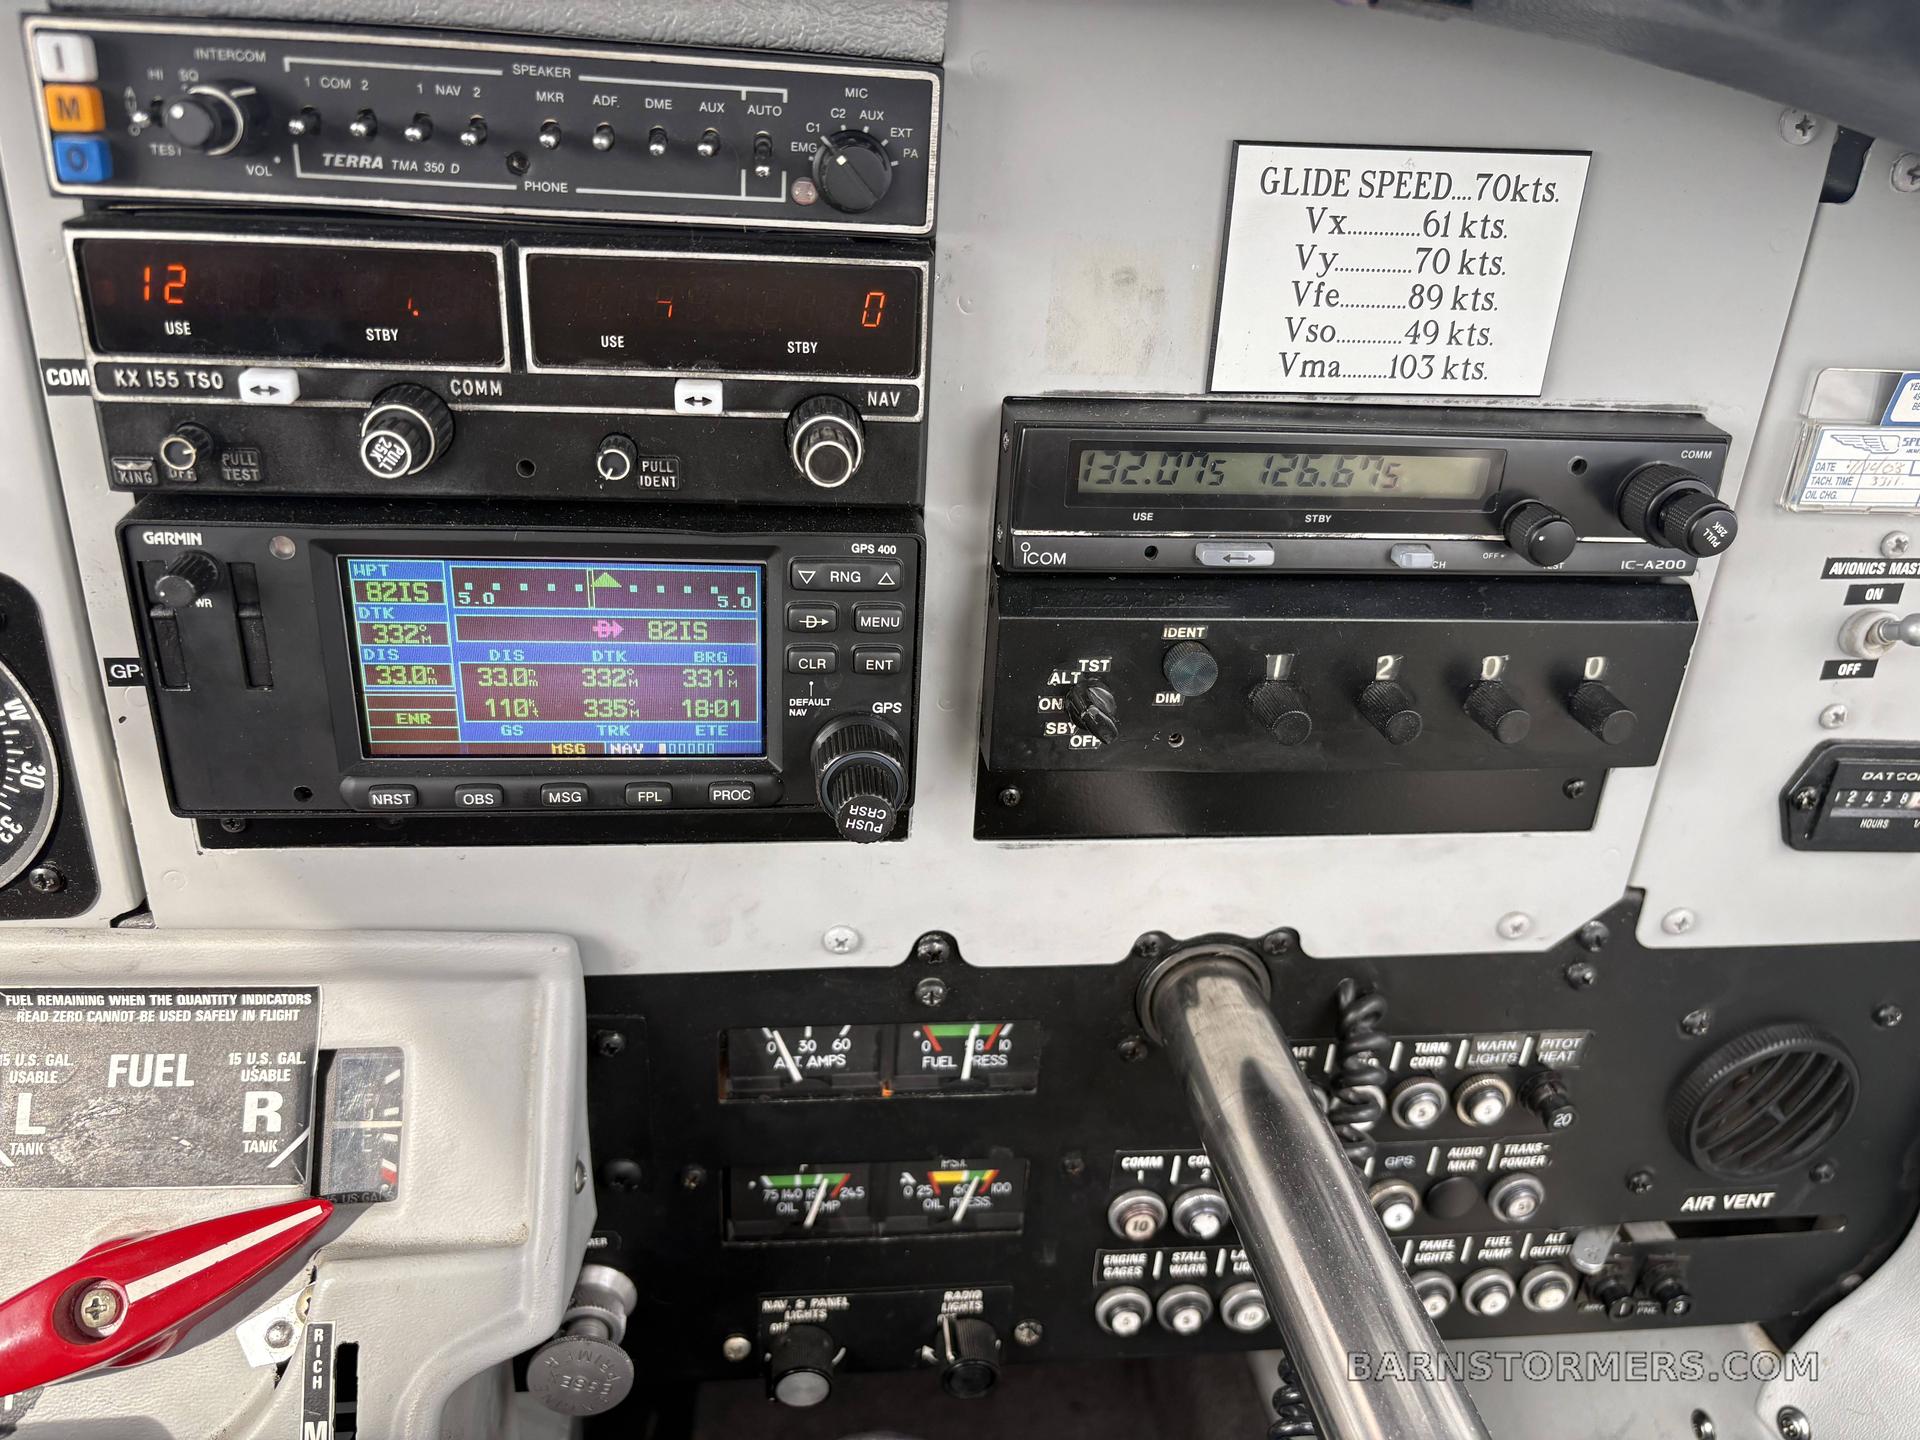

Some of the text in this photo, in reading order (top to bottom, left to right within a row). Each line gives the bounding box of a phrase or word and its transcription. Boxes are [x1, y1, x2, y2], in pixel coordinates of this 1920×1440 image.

[195, 49, 267, 63] INTERCOM
[512, 64, 572, 79] SPEAKER
[320, 77, 352, 90] COM
[435, 83, 462, 96] NAV
[536, 91, 565, 104] MKR
[845, 86, 869, 99] MIC
[645, 98, 673, 110] DME
[699, 101, 725, 114] AUX
[747, 104, 782, 118] AUTO
[830, 108, 846, 120] C2
[859, 108, 884, 121] AUX
[805, 122, 821, 134] C1
[890, 127, 913, 139] EXT
[791, 142, 817, 154] EMG
[903, 147, 919, 159] PA
[322, 153, 445, 174] TERRA TMA 350
[246, 165, 273, 177] VOL
[524, 181, 568, 194] PHONE
[1260, 167, 1350, 198] GLIDE
[1459, 210, 1508, 239] kts.
[1457, 247, 1506, 276] kts.
[143, 263, 187, 305] 12
[1450, 284, 1498, 311] kts.
[165, 321, 191, 336] USE
[366, 328, 399, 342] STBY
[1446, 320, 1493, 347] kts.
[600, 335, 625, 348] USE
[787, 341, 818, 354] STBY
[1441, 355, 1488, 381] kts.
[114, 370, 224, 390] KX 155 TSO
[450, 379, 502, 397] COMM
[867, 392, 900, 408] NAV
[222, 452, 257, 467] PULL
[1681, 451, 1712, 460] COMM
[642, 460, 674, 474] PULL
[1815, 462, 1836, 471] DATE
[118, 470, 153, 484] KING
[223, 469, 259, 482] TEST
[640, 475, 677, 489] IDENT
[1835, 477, 1853, 486] TIME
[1805, 491, 1819, 499] OIL
[1133, 513, 1153, 521] USE
[1305, 515, 1331, 523] STBY
[142, 531, 203, 546] GARMIN
[851, 544, 897, 555] GPS 400
[352, 564, 389, 577] WPT
[1621, 559, 1686, 571] IC-A200
[1829, 562, 1885, 575] AVIONICS
[830, 571, 861, 584] RNG
[366, 582, 429, 603] 82IS
[458, 592, 495, 605] 5.0
[1865, 588, 1884, 600] ON
[717, 596, 751, 609] 5.0
[359, 607, 395, 620] DTK
[861, 616, 900, 628] MENU
[648, 621, 708, 641] 82IS
[1163, 628, 1205, 639] IDENT
[364, 648, 399, 661] DIS
[489, 649, 525, 662] DIS
[592, 650, 627, 663] DTK
[693, 651, 728, 664] BRG
[798, 659, 826, 670] CLR
[866, 660, 893, 671] ENT
[1079, 660, 1110, 673] TST
[1838, 663, 1861, 676] OFF
[1049, 672, 1081, 684] ALT
[789, 698, 831, 707] DEFAULT
[1038, 698, 1063, 711] ON
[1155, 693, 1181, 704] DIM
[682, 699, 741, 719] 18:01
[789, 709, 807, 717] NAV
[872, 702, 902, 715] GPS
[396, 712, 432, 725] ENR
[501, 725, 524, 737] GS
[597, 725, 631, 737] TRK
[695, 725, 729, 737] ETE
[1045, 722, 1076, 735] SBY
[551, 743, 586, 755] MSG
[610, 743, 643, 755] NAV
[372, 793, 412, 806] NRST
[463, 793, 494, 806] OBS
[549, 791, 582, 804] MSG
[638, 791, 662, 803] FPL
[713, 789, 751, 802] PROC
[849, 804, 887, 820] CRSR
[846, 819, 883, 834] PUSH
[1860, 819, 1890, 829] HOURS
[7, 994, 312, 1006] FUEL REMAINING WHEN THE QUANTITY INDICATORS
[17, 1010, 300, 1022] READ ZERO CANNOT USED SAFELY IN FLIGHT
[1415, 1042, 1449, 1054] TURN
[1477, 1040, 1517, 1051] WARN
[1540, 1038, 1582, 1049] PITOT
[15, 1054, 74, 1066] U.S. GAL.
[229, 1052, 306, 1066] 15 U.S. GAL.
[806, 1054, 846, 1067] AMPS
[923, 1055, 956, 1067] FUEL
[1469, 1053, 1519, 1065] LIGHTS
[1539, 1051, 1575, 1062] HEAT
[108, 1053, 195, 1088] FUEL
[241, 1069, 291, 1082] USABLE
[9, 1071, 58, 1084] USABLE
[15, 1092, 47, 1135] L
[243, 1090, 284, 1133] R
[1553, 1114, 1573, 1127] 20
[9, 1143, 44, 1155] TANK
[243, 1140, 278, 1153] TANK
[1447, 1147, 1484, 1158] AUDIO
[1504, 1143, 1550, 1155] TRANS-
[1122, 1156, 1164, 1169] COMM
[1385, 1155, 1415, 1167] GPS
[1448, 1160, 1476, 1171] MKR
[1499, 1155, 1545, 1168] PONDER
[1681, 1192, 1775, 1211] AIR VENT
[1419, 1239, 1455, 1251] PANEL
[1485, 1236, 1512, 1248] FUEL
[1545, 1233, 1566, 1245] ALT
[1103, 1253, 1147, 1266] ENGINE
[1172, 1251, 1206, 1263] STALL
[1415, 1251, 1455, 1264] LIGHTS
[1478, 1248, 1513, 1260] PUMP
